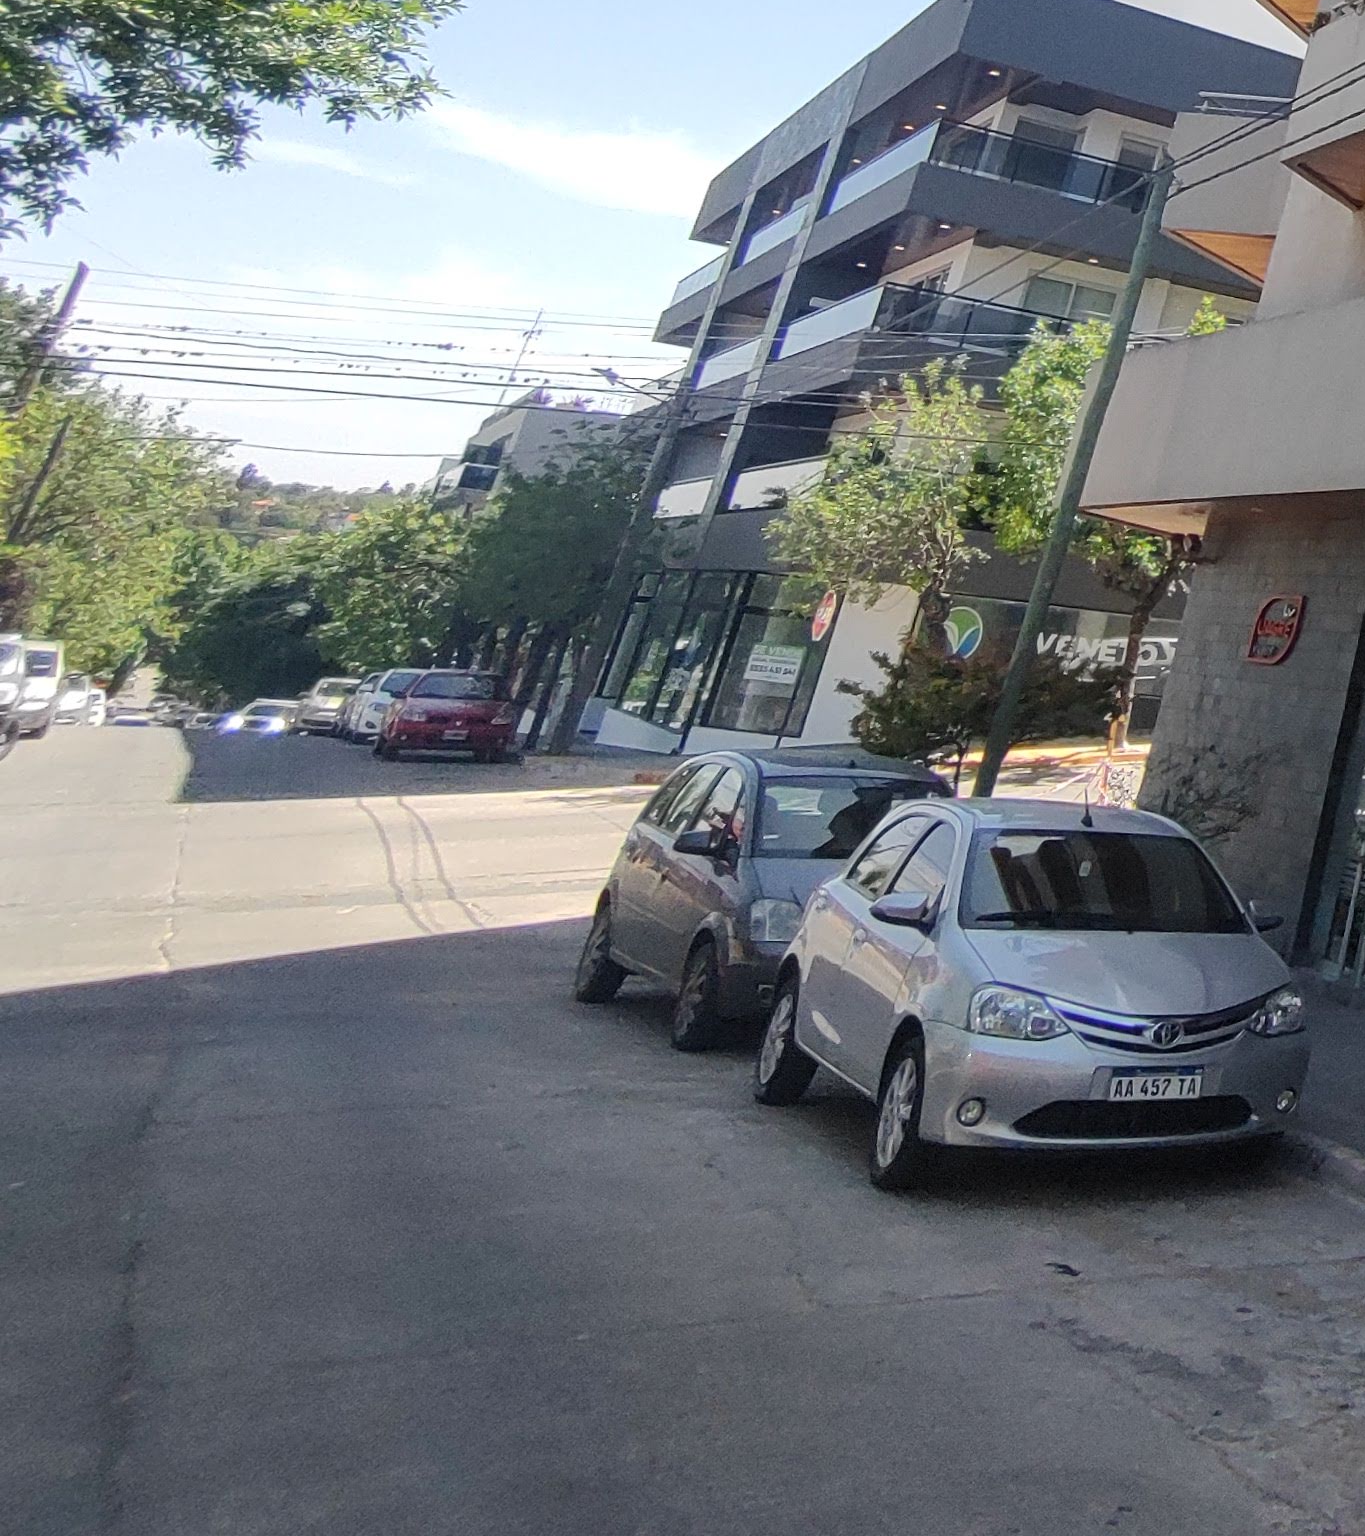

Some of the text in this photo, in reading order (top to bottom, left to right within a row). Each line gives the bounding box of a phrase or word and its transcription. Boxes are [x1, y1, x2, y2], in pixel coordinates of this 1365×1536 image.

[1036, 631, 1158, 667] VENEO
[1113, 1077, 1197, 1098] AA 457 TA
